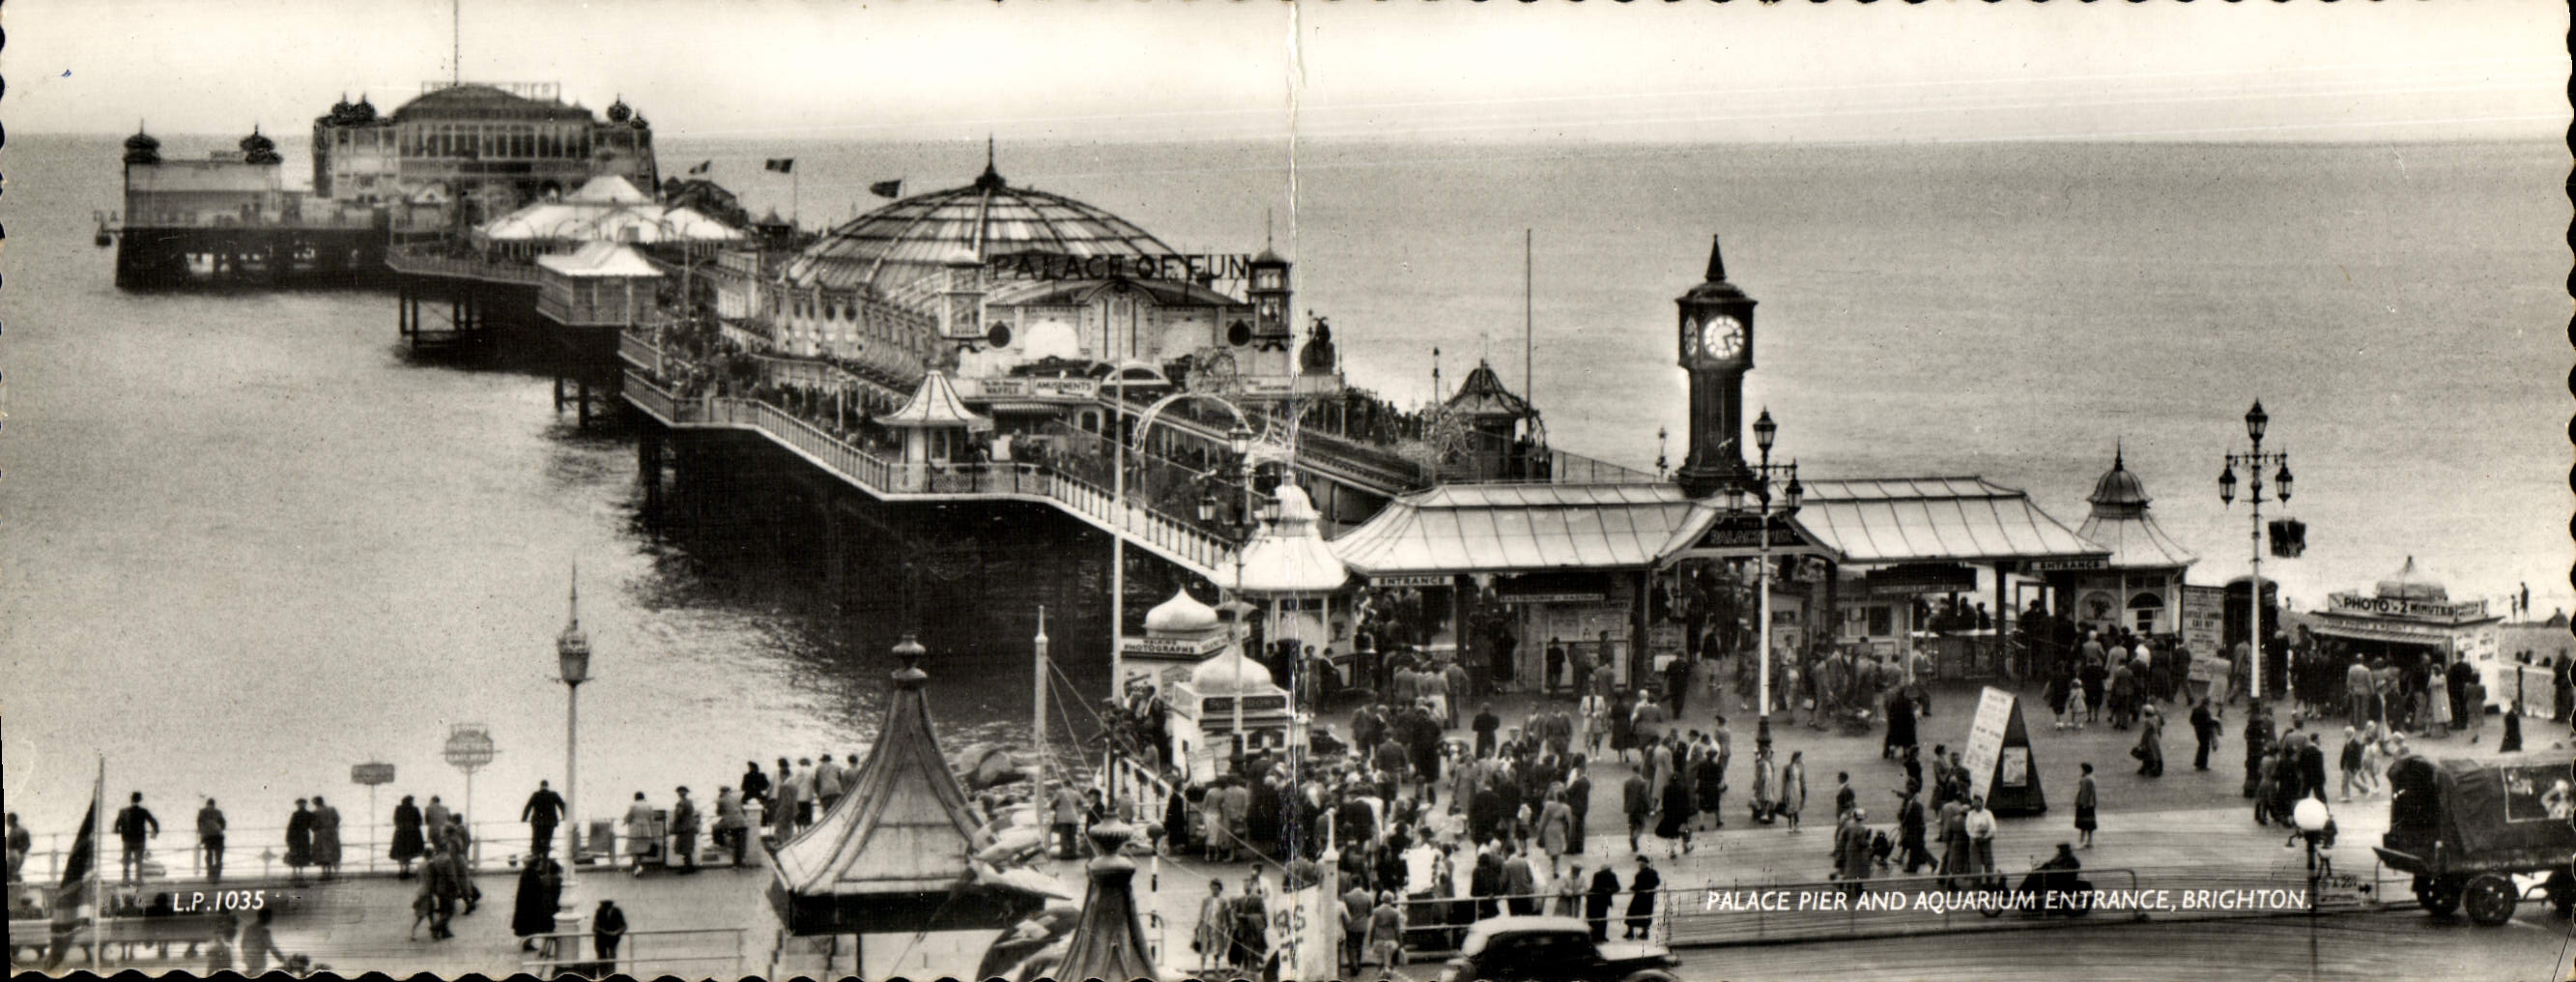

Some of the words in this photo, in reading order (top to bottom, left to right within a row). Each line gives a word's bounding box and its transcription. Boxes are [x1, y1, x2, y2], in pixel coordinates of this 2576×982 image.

[993, 253, 1126, 280] PALACE
[1135, 253, 1178, 280] OF
[1188, 253, 1251, 280] FUN
[1036, 381, 1092, 390] AMUSEMENTS
[1709, 529, 1762, 544] PALACE
[2040, 561, 2100, 569] ENTRANCE
[1379, 576, 1445, 586] ENTRANCE
[2343, 596, 2390, 613] PHOTO
[2399, 600, 2408, 614] 2
[2410, 603, 2455, 617] MINUTES
[1124, 644, 1195, 654] PHOTOGRAPHS
[1208, 697, 1282, 709] SOUDOWN
